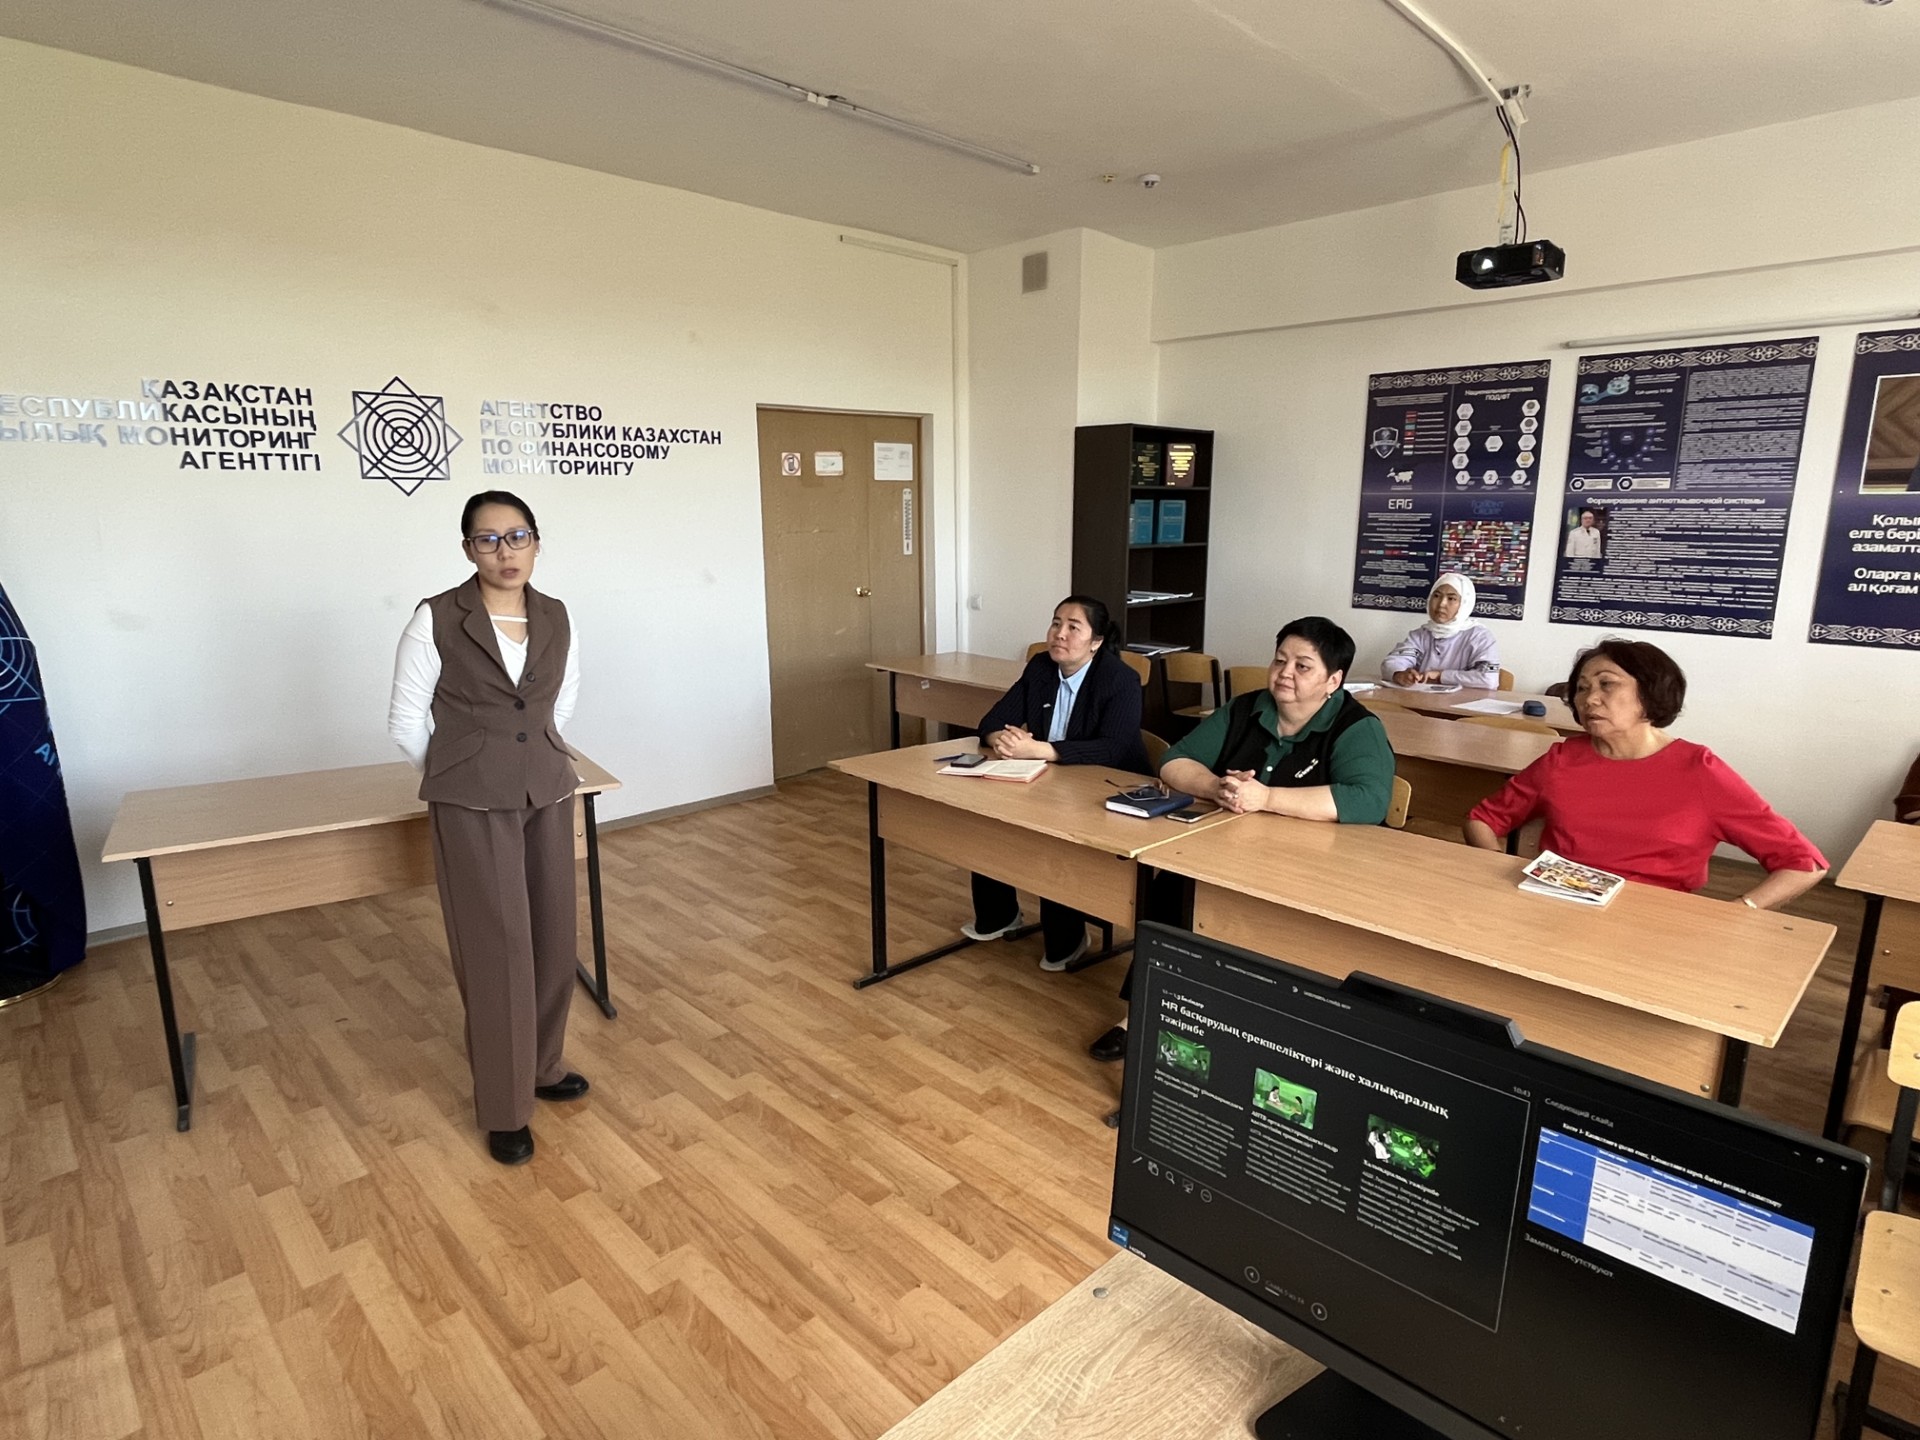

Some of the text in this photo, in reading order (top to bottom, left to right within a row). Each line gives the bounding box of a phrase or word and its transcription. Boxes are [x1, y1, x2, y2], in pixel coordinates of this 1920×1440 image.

[141, 378, 313, 406] ҚАЗАҚСТАН
[480, 399, 603, 421] АГЕНТСТВО
[118, 424, 316, 449] МОНИТОРИНГ
[480, 419, 722, 445] РЕСПУБЛИКИ КАЗАХСТАН
[481, 438, 670, 460] ПО ФИНАНСОВОМУ
[179, 451, 321, 471] АГЕНТТІГІ
[483, 457, 634, 476] МОНИТОРИНГУ
[1388, 499, 1413, 510] EAG
[1849, 529, 1885, 539] елге
[1854, 567, 1912, 582] Оларға
[1847, 583, 1919, 595] ал қоғам
[1161, 999, 1178, 1013] HR
[1180, 1005, 1240, 1038] басқарудың
[1241, 1030, 1322, 1069] ерекшеліктері
[1324, 1062, 1356, 1082] және
[1358, 1076, 1449, 1120] халықаралық
[1524, 1233, 1559, 1254] Заметки
